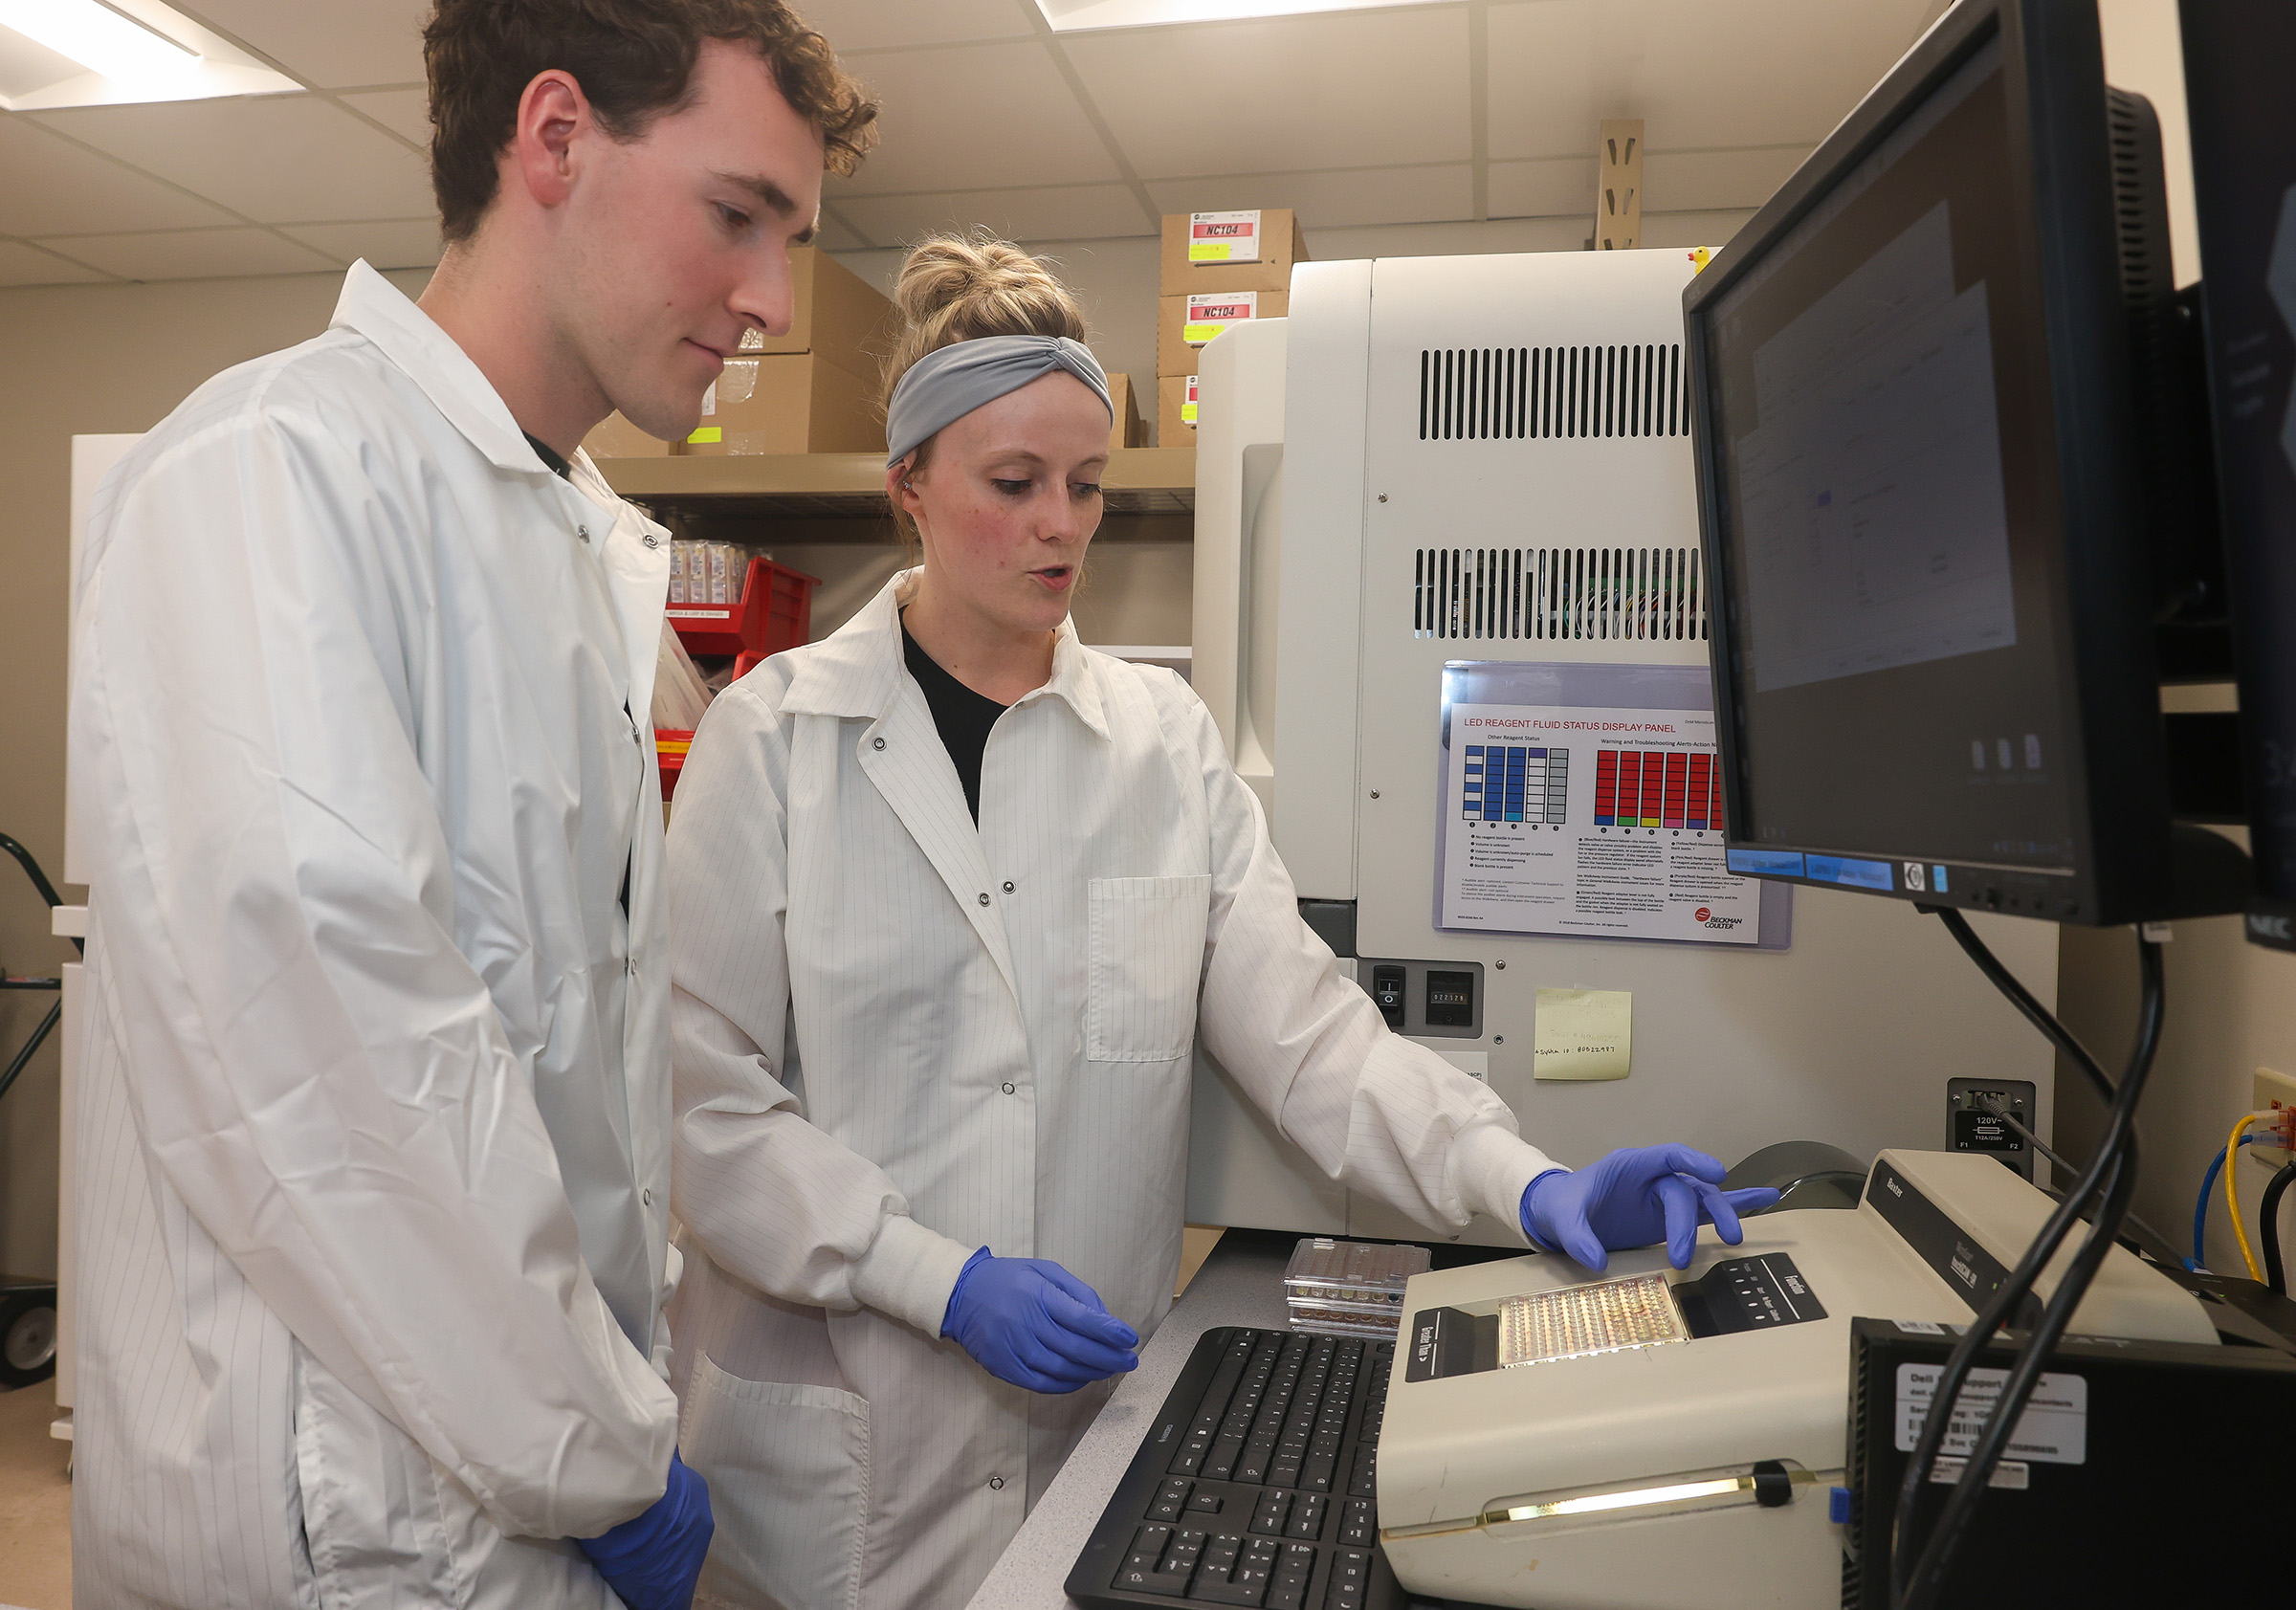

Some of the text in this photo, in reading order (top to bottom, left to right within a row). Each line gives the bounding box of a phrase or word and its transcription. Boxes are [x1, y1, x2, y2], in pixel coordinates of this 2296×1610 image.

[1206, 225, 1238, 235] NC104
[1203, 306, 1235, 318] NC104
[1464, 718, 1676, 733] LED REAGENT FLUID STATUS DISPLAY PANEL
[1704, 921, 1733, 930] COULTER
[1887, 1177, 1903, 1198] Baxter
[1784, 1274, 1805, 1295] Function
[1420, 1326, 1434, 1344] Greater
[1910, 1374, 1933, 1383] Dell
